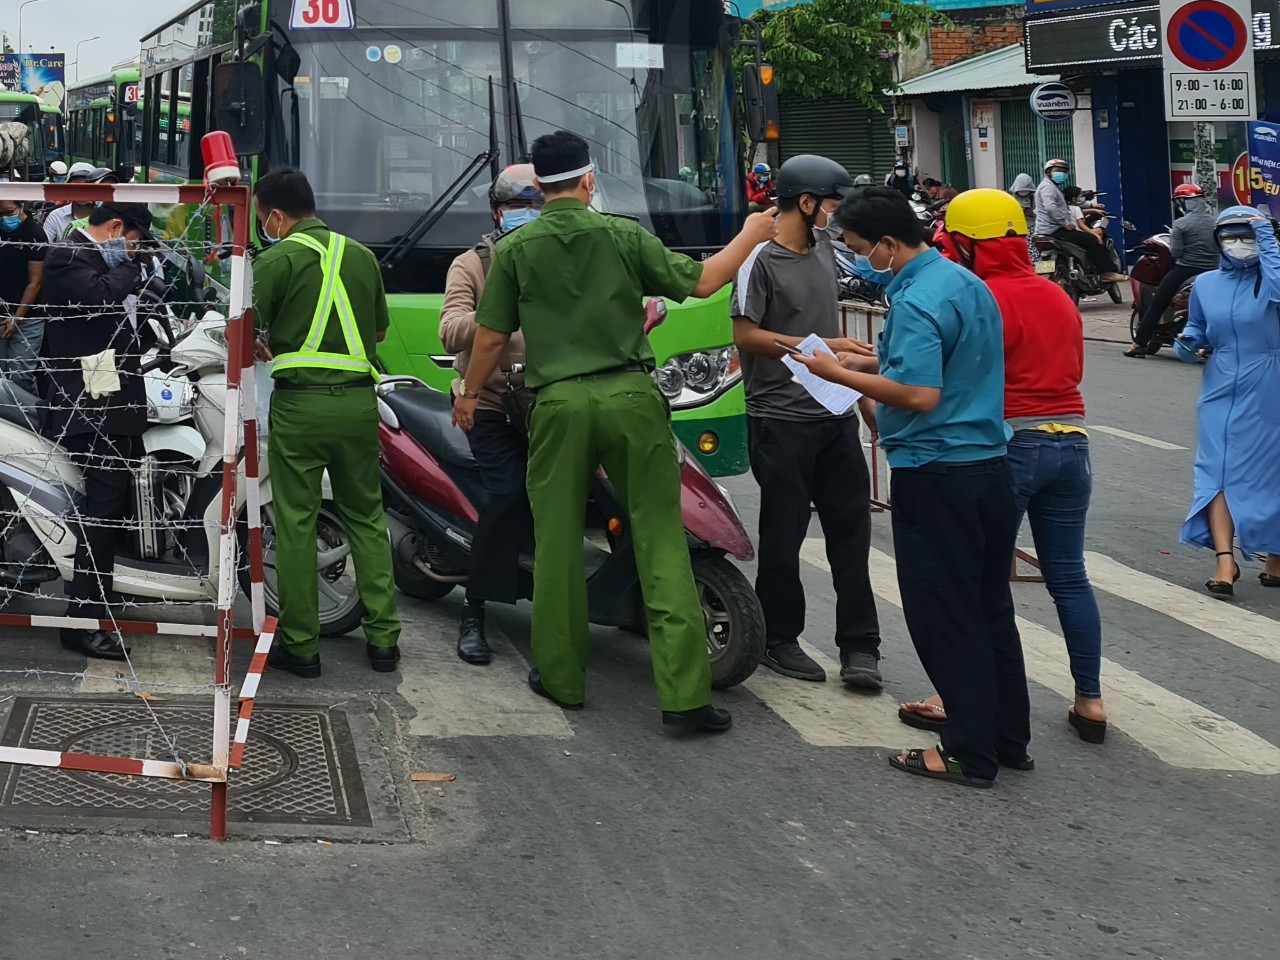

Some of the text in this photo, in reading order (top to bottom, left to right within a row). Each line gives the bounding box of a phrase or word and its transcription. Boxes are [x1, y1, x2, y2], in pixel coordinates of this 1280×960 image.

[1108, 17, 1158, 51] Các
[23, 58, 64, 68] Dr.Care
[1176, 79, 1200, 91] 9:00
[1213, 79, 1244, 91] 16:00
[1177, 98, 1207, 110] 21:00
[1220, 98, 1244, 110] 6:00
[1236, 166, 1245, 191] 1
